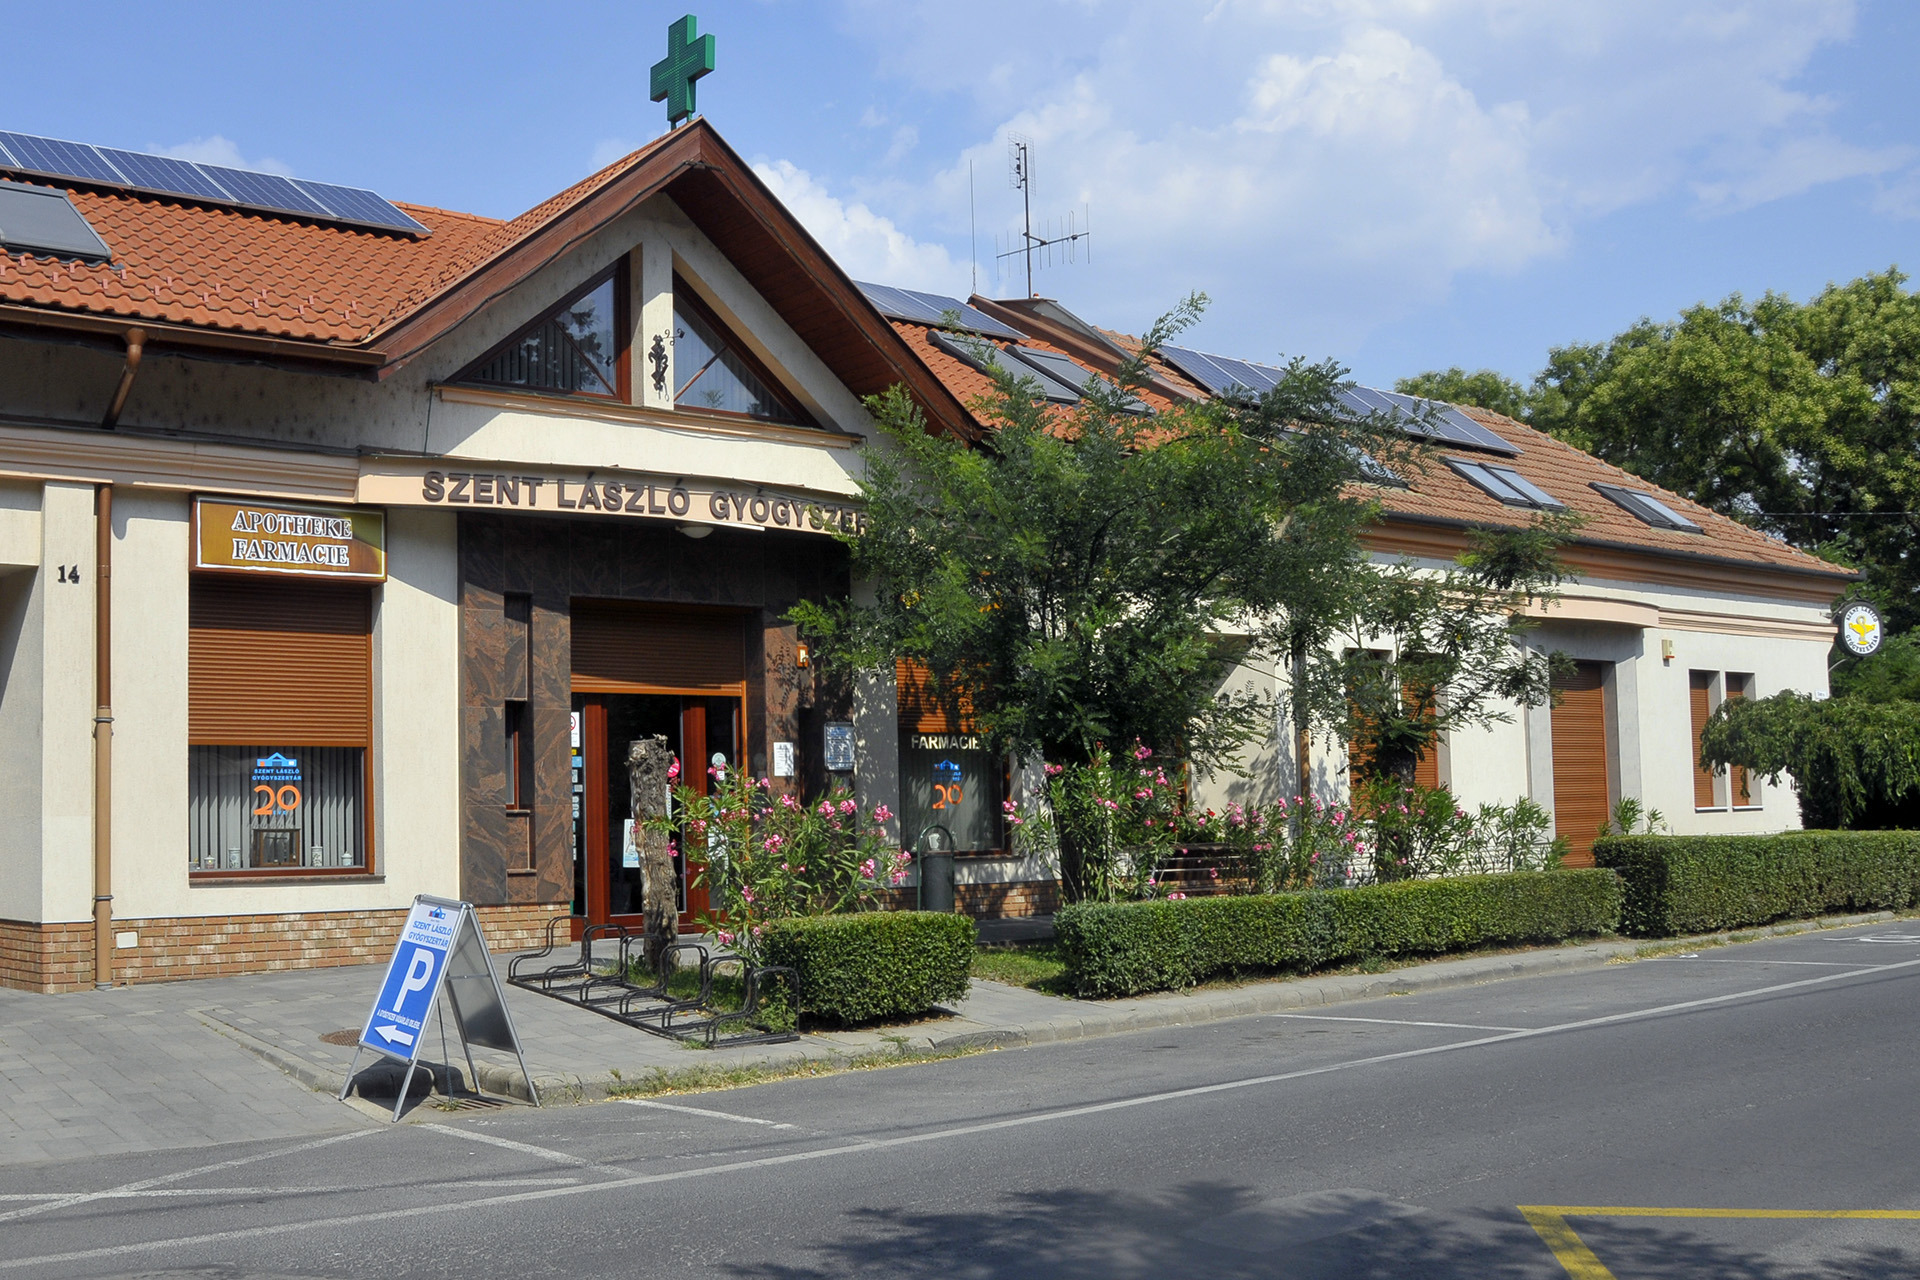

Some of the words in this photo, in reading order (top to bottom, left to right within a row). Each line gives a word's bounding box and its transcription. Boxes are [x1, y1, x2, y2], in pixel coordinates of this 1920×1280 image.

[422, 470, 544, 507] SZENT
[557, 471, 691, 517] LÁSZLÓ
[709, 486, 868, 536] GYÓGYSZER
[231, 510, 352, 539] APOTHEKE
[232, 538, 350, 566] FARMACIE
[57, 564, 80, 585] 14
[254, 785, 300, 815] 20
[932, 784, 963, 809] 20
[413, 920, 431, 931] SZENT
[431, 923, 452, 936] LÁSZLÓ
[393, 947, 435, 1012] P
